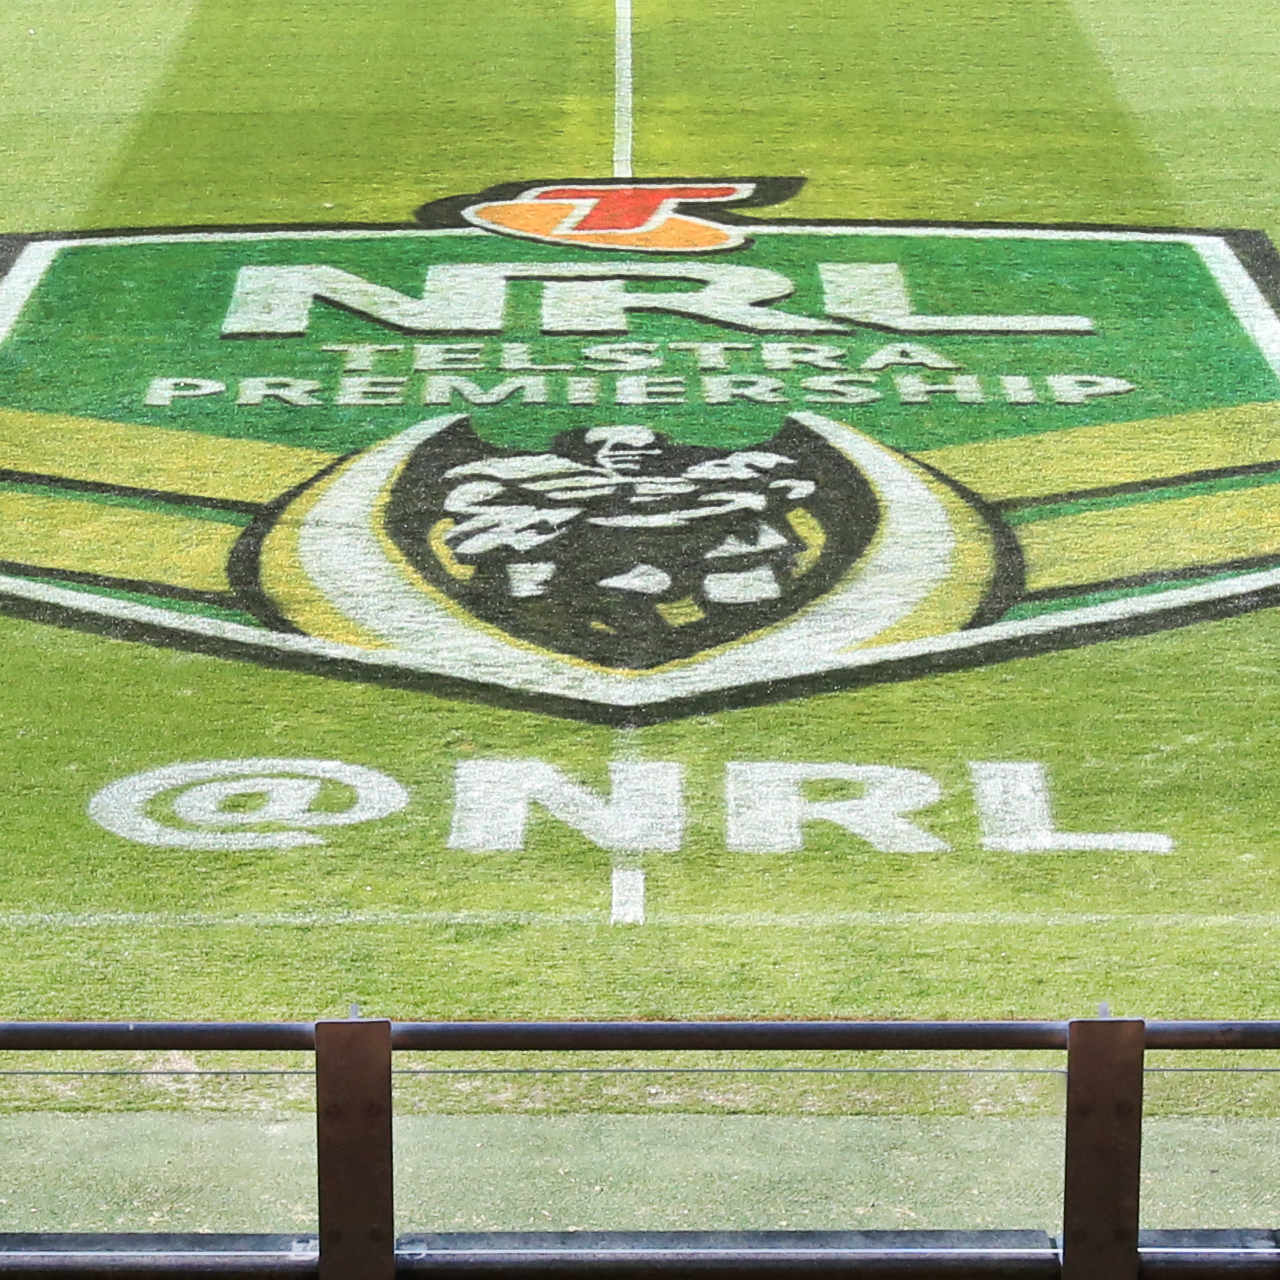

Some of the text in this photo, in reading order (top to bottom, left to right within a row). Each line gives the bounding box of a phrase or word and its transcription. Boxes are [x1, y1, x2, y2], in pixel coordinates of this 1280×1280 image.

[220, 263, 1096, 337] NRL
[324, 342, 960, 372] TELSTRA
[143, 376, 1137, 407] PREMIERSHIP
